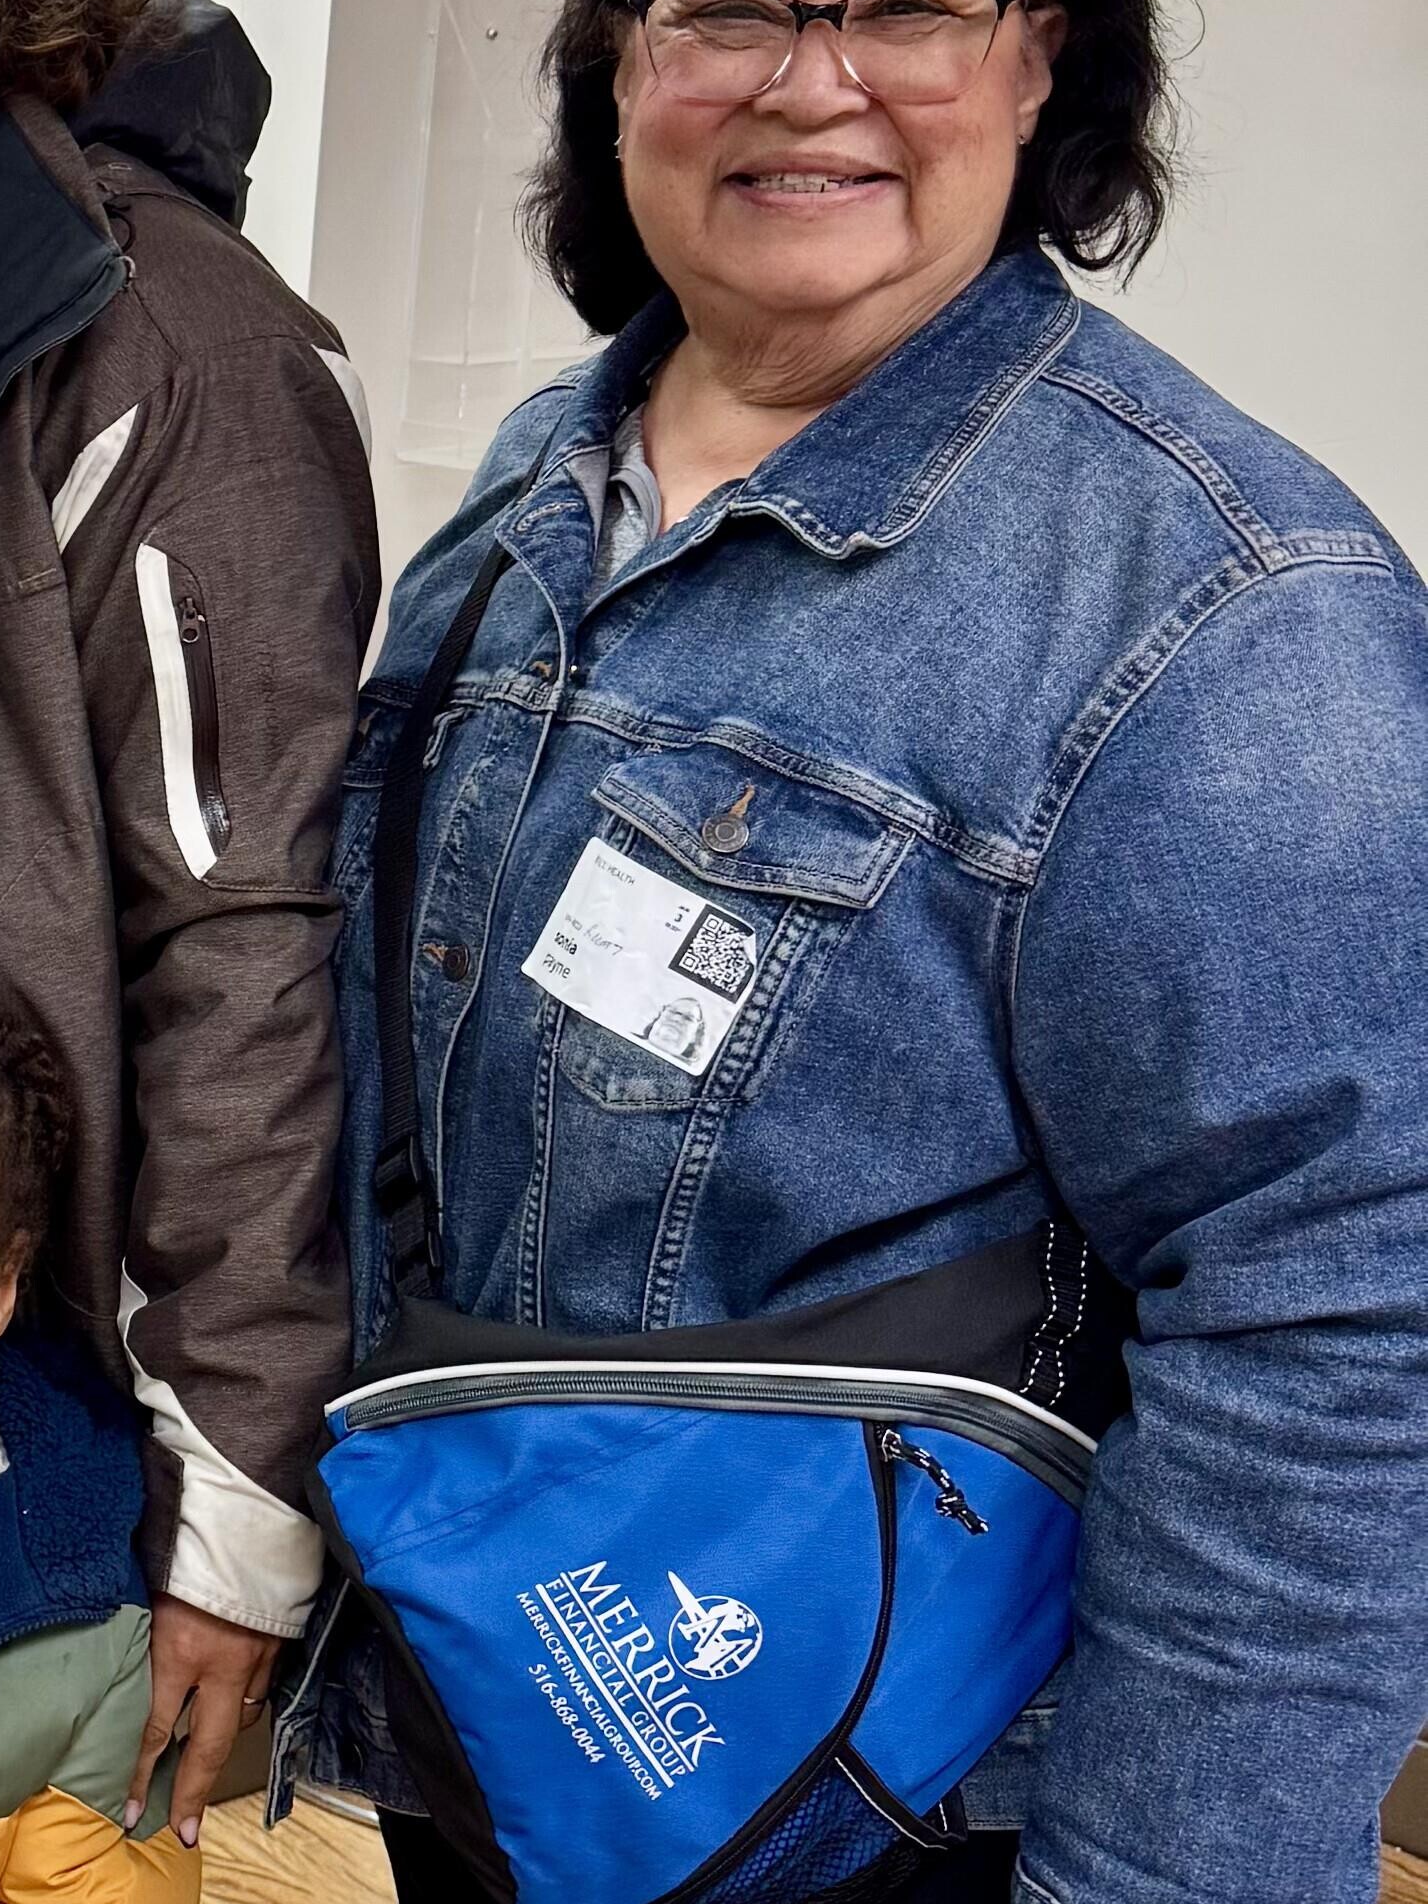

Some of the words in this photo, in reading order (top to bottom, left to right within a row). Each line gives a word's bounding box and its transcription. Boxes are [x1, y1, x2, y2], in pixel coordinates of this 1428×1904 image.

[516, 1591, 662, 1801] MERRICKFINANCIALGROUP.COM
[528, 1663, 606, 1764] 516-868-0044
[545, 1578, 634, 1708] FINANCIAL
[631, 1710, 687, 1777] GROUP
[568, 1560, 726, 1768] MERRICK
